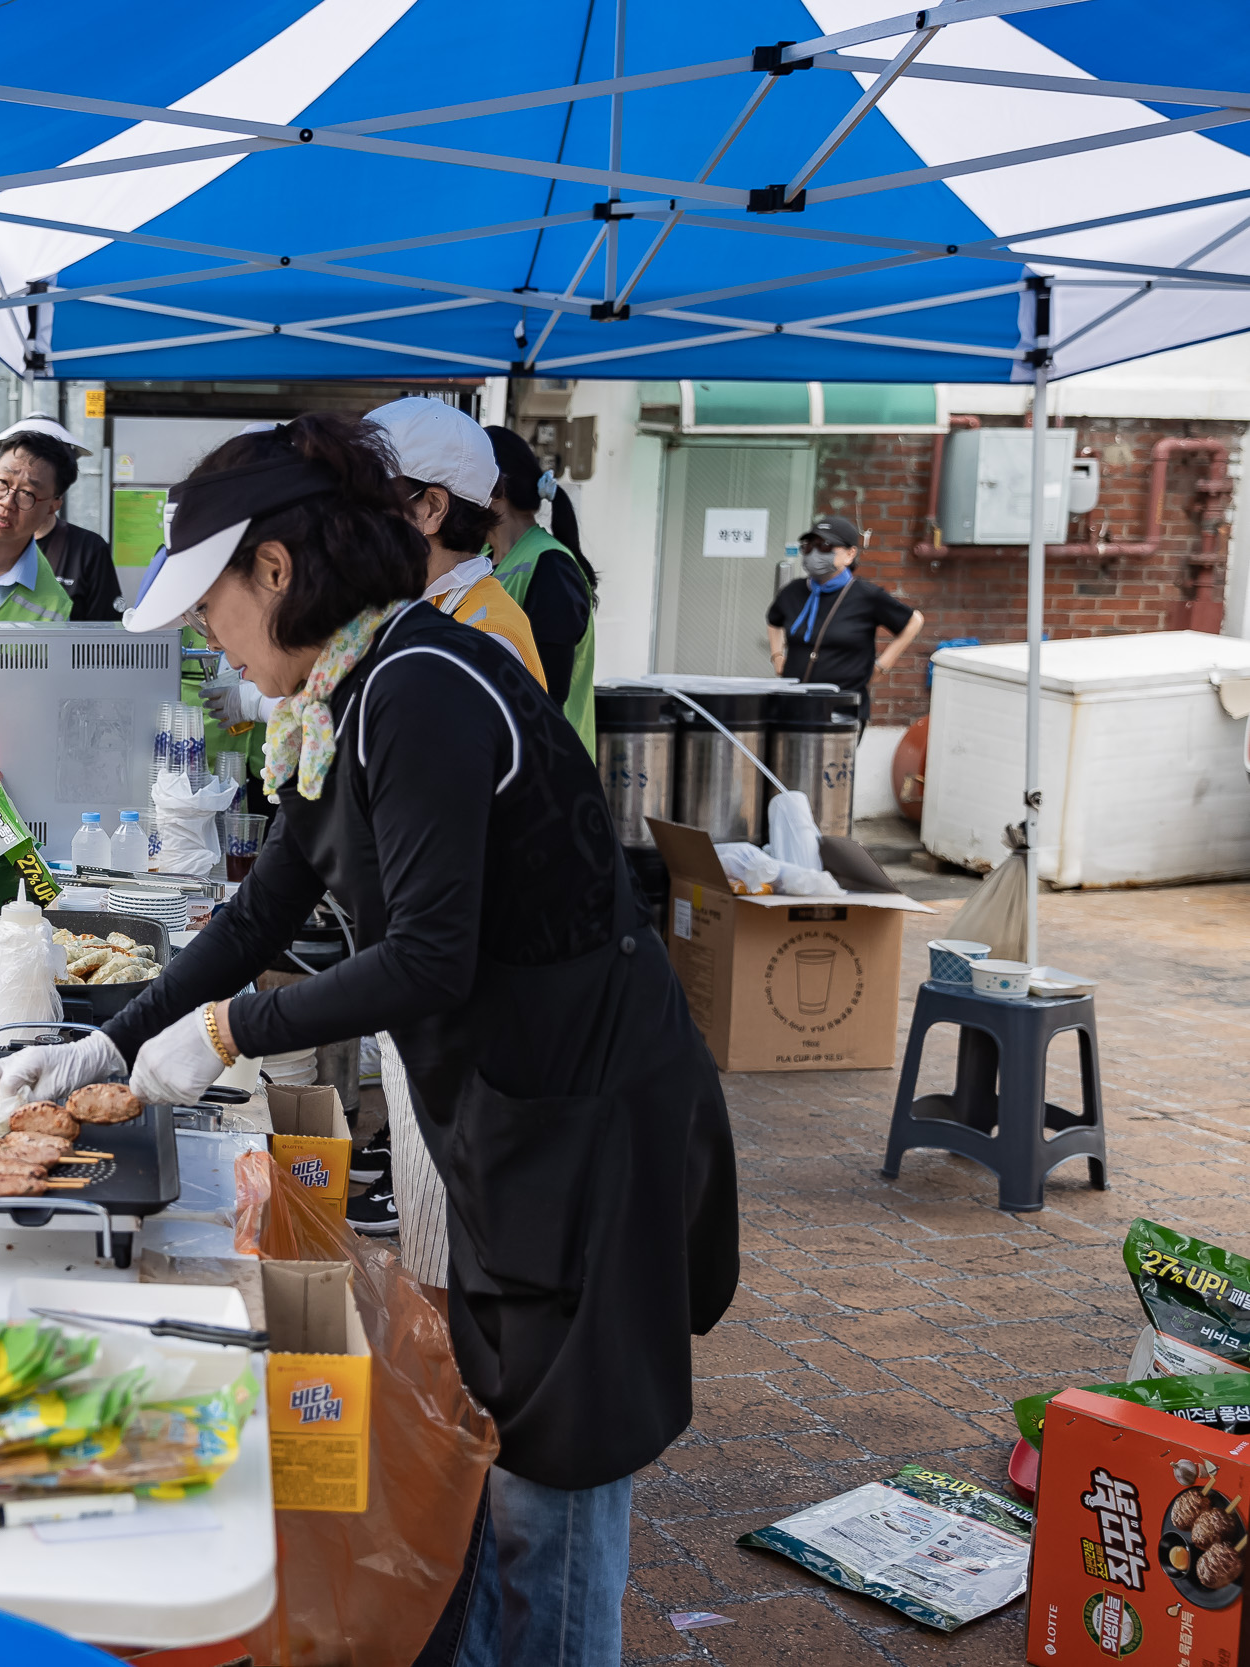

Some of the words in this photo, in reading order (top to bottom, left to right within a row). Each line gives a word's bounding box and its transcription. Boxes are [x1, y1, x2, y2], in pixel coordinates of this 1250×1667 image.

[718, 529, 752, 543] 화장실
[16, 853, 41, 887] 27%
[776, 1055, 791, 1063] PLA
[291, 1159, 322, 1176] 비타
[1141, 1250, 1185, 1284] 27%
[1186, 1266, 1229, 1300] UP!
[1200, 1326, 1241, 1349] 비비고
[290, 1384, 332, 1409] 비타
[300, 1398, 342, 1424] 파워
[915, 1471, 948, 1488] 27%
[949, 1479, 982, 1496] UP!
[1048, 1604, 1058, 1643] LOTTE
[1102, 1595, 1122, 1653] 의성마늘
[1178, 1610, 1195, 1655] 육즙가득
